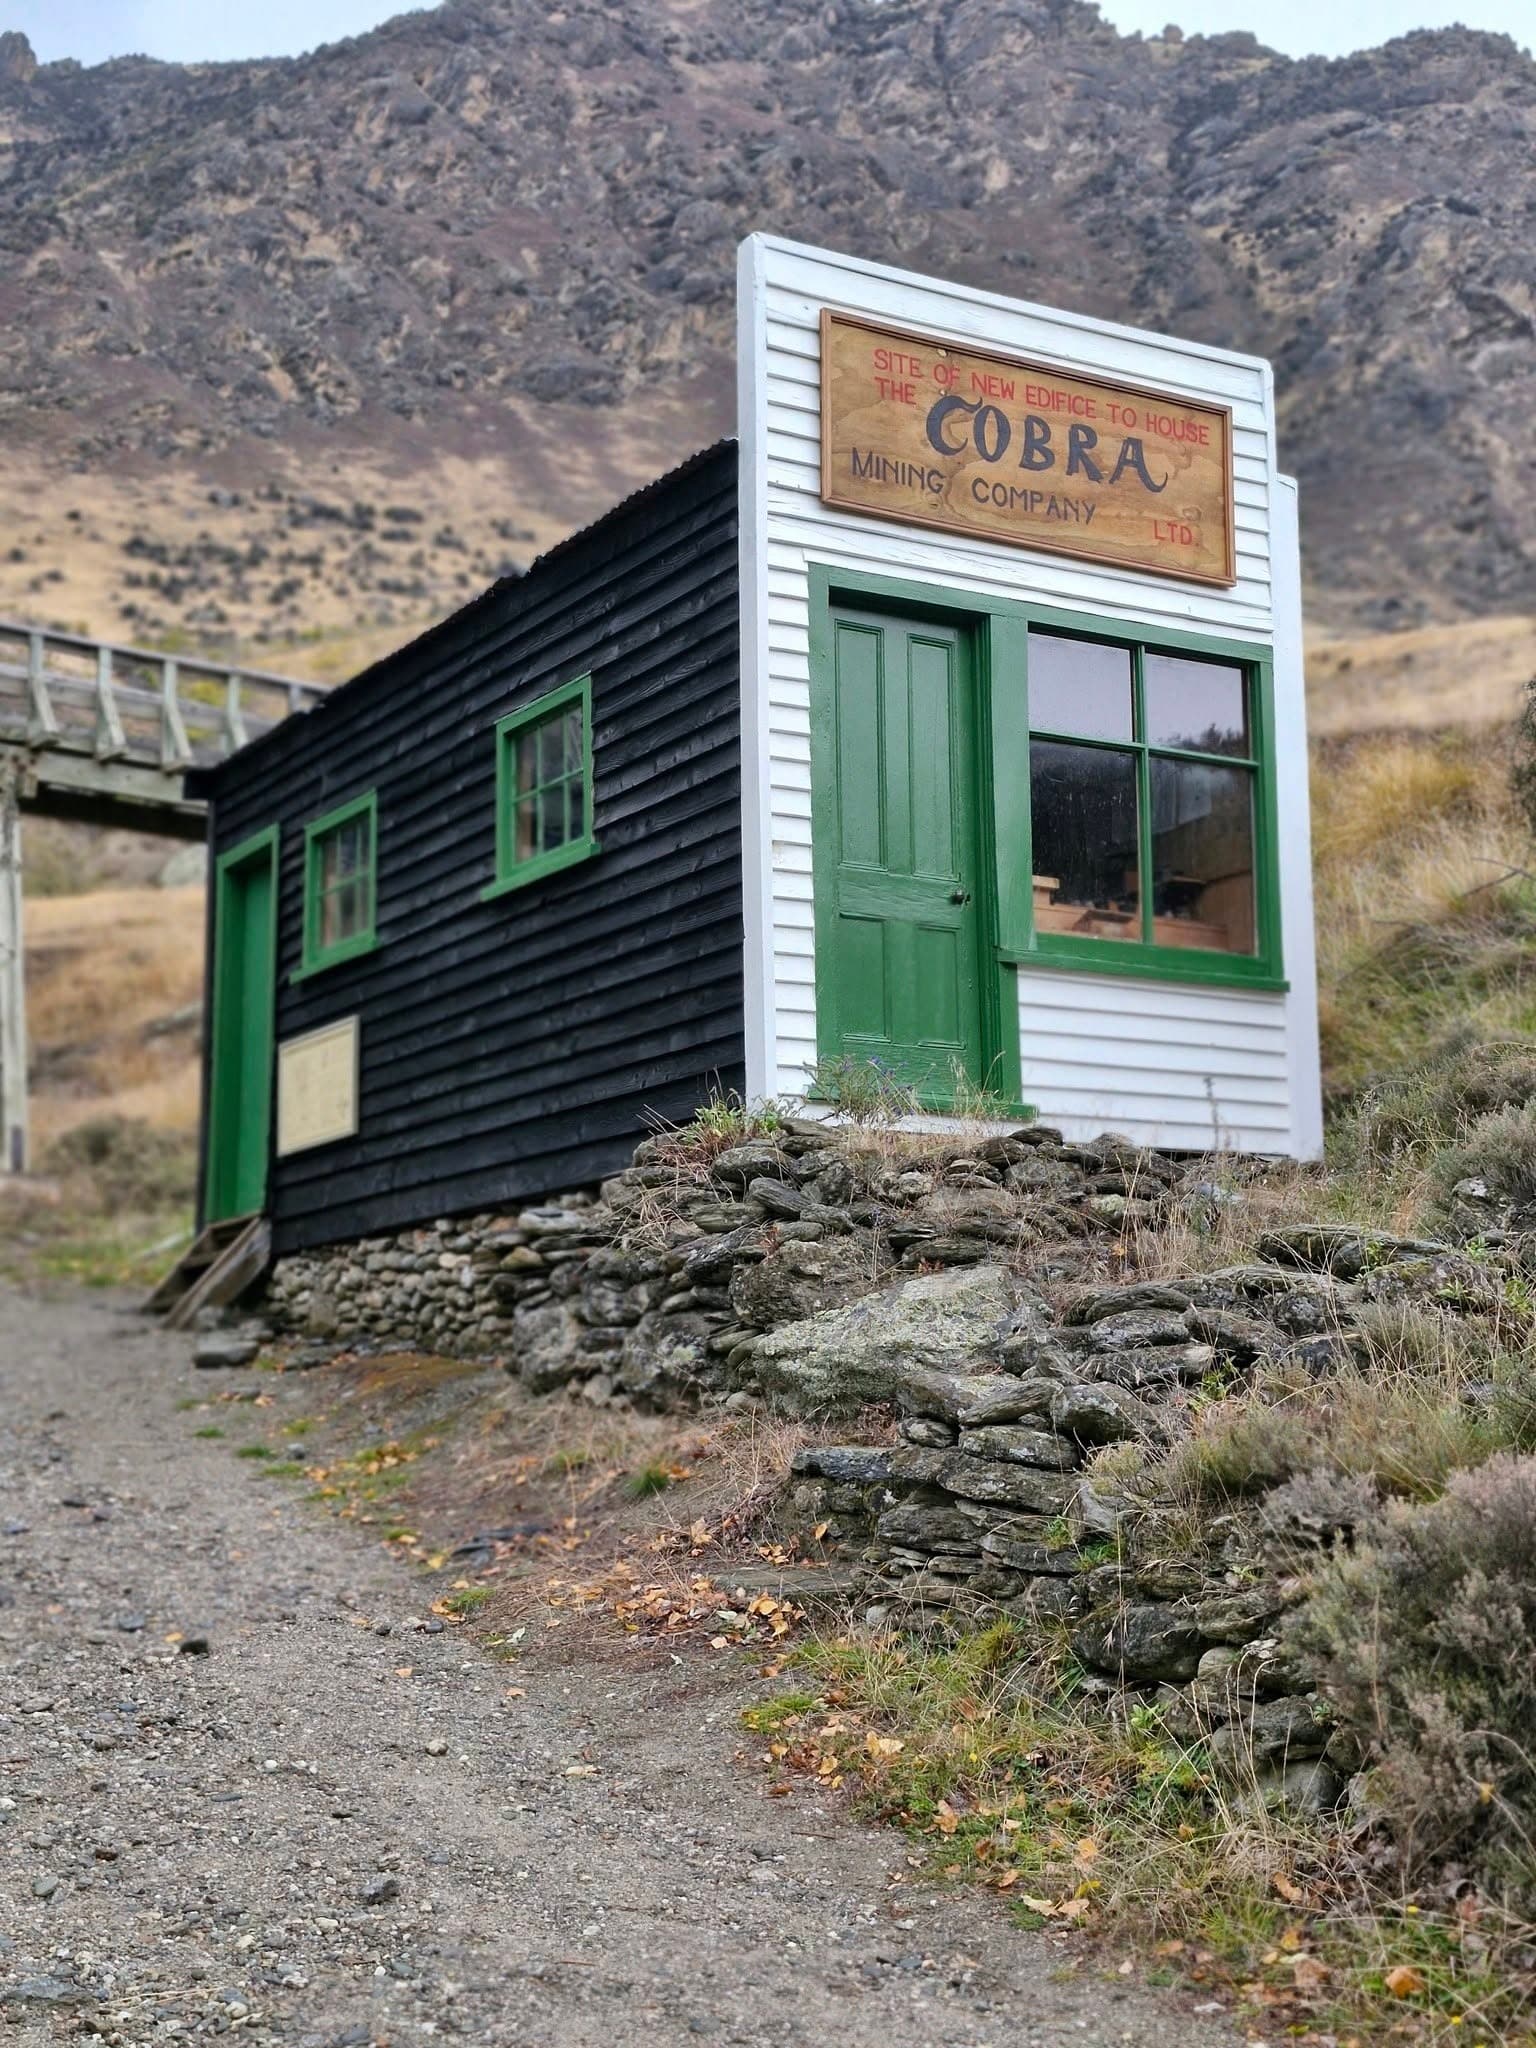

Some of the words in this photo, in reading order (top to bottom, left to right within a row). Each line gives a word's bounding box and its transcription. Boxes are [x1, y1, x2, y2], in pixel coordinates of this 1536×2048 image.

[874, 376, 917, 405] THE
[874, 348, 921, 378] SITE
[933, 362, 961, 387] OF
[971, 371, 1015, 401] NEW
[1025, 384, 1097, 420] EDIFICE
[1106, 403, 1137, 428] TO
[1145, 413, 1210, 446] HOUSE
[851, 446, 945, 494] MINING
[971, 477, 1096, 525] COMPANY
[926, 394, 1169, 493] COBRA
